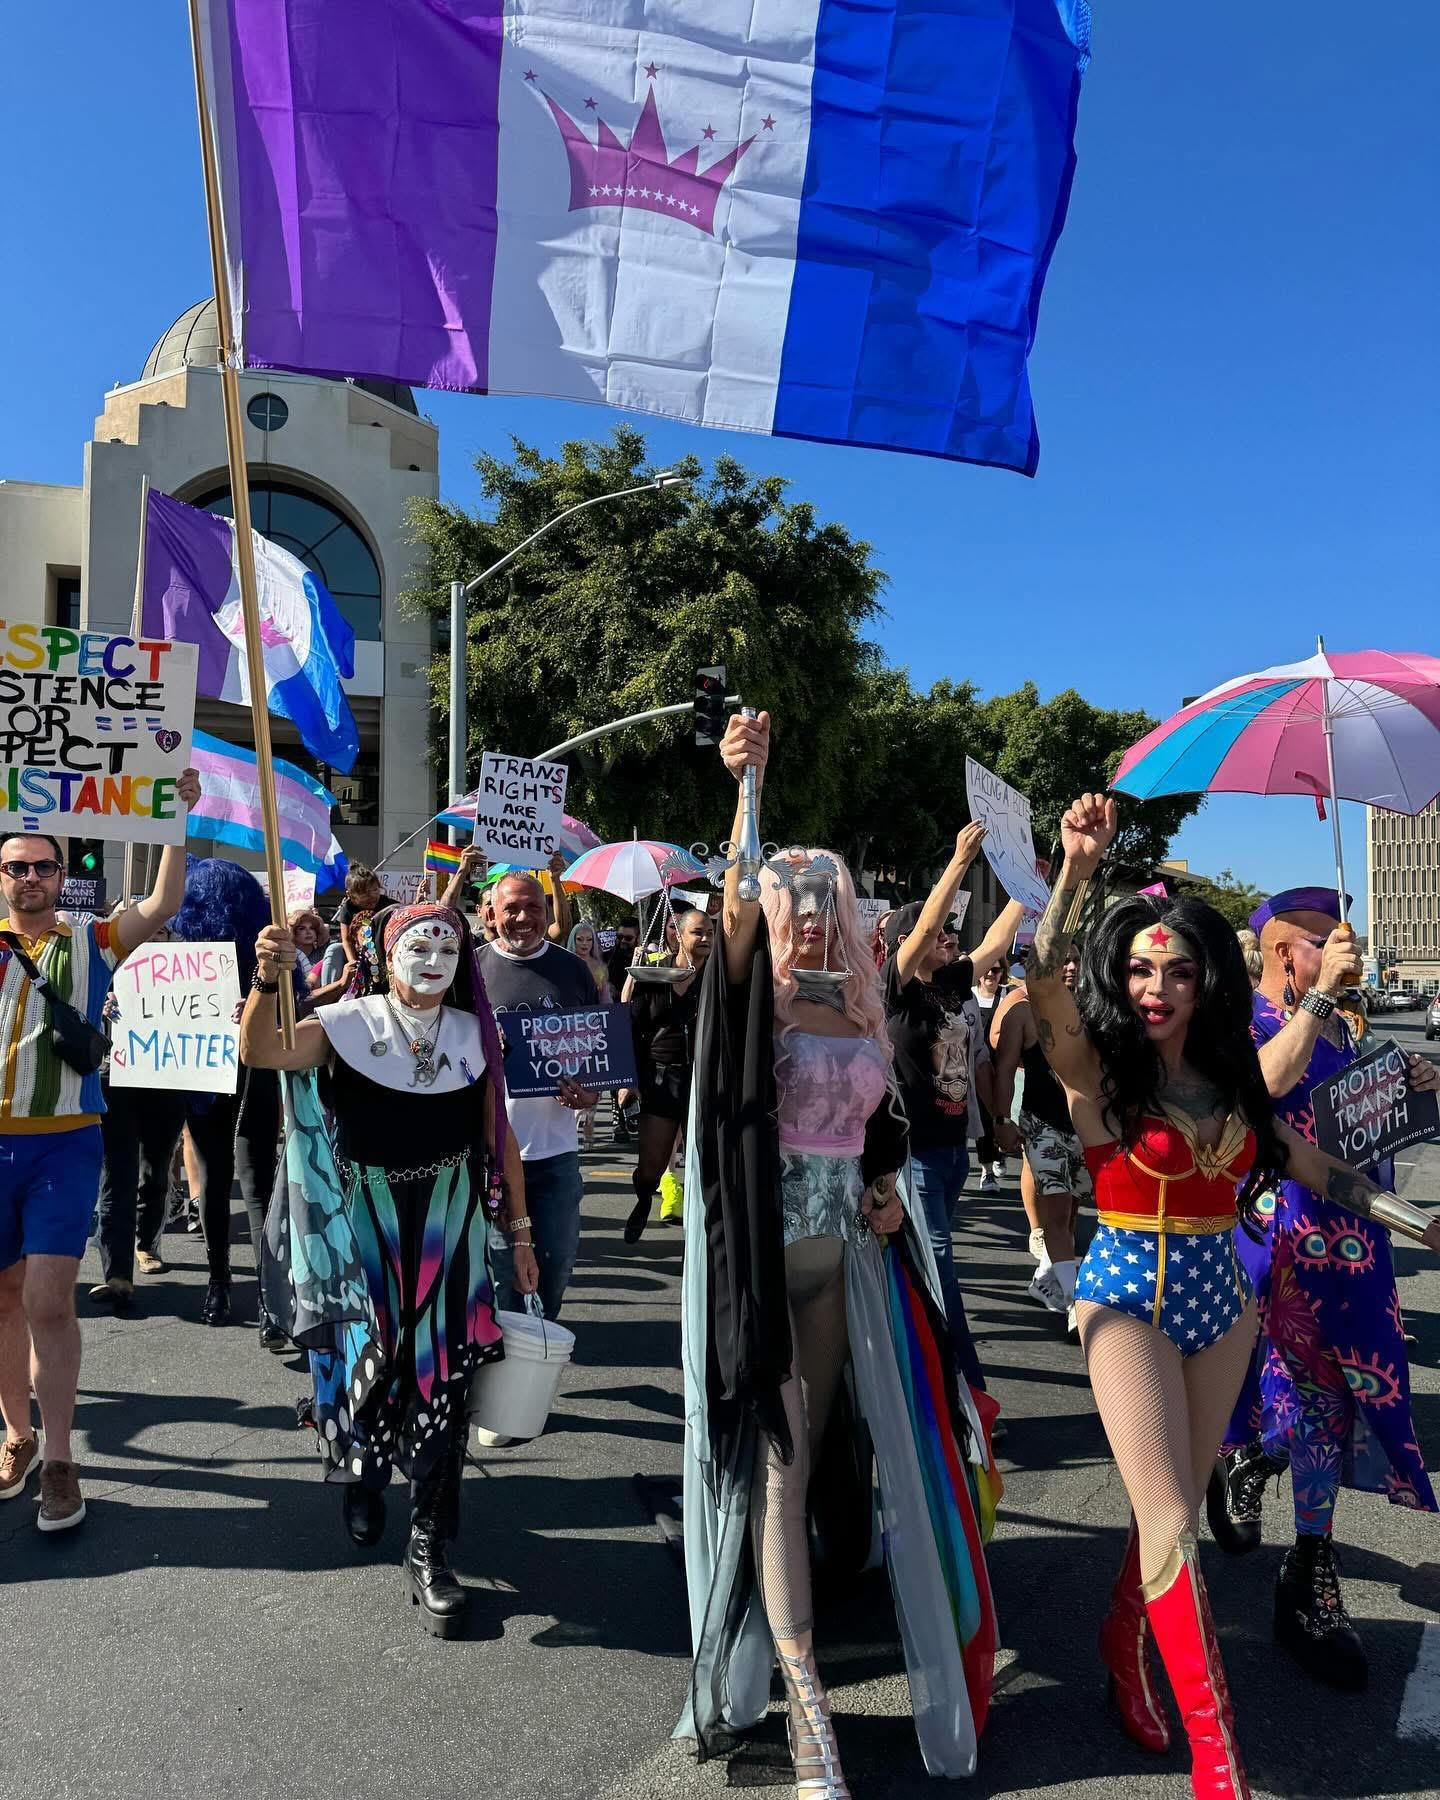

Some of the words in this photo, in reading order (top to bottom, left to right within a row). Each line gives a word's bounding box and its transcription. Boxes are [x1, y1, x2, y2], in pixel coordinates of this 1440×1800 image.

[0, 619, 172, 682] SPECT
[7, 704, 70, 741] OR
[0, 731, 138, 775] PECT
[488, 758, 566, 784] TRANS
[967, 760, 1002, 801] TAKING
[1002, 784, 1009, 808] A
[0, 767, 177, 819] ISTANCE
[484, 776, 563, 804] RIGHTS
[477, 813, 545, 834] HUMAN
[503, 803, 537, 819] ARE
[486, 829, 554, 855] RIGHTS
[61, 887, 95, 897] TRANS
[64, 879, 98, 889] ROTECT
[59, 895, 95, 905] YOUTH
[124, 951, 218, 993] TRANS
[142, 993, 221, 1020] LIVES
[520, 1011, 609, 1036] PROTECT
[128, 1029, 237, 1072] MATTER
[526, 1033, 608, 1058] TRANS
[529, 1054, 610, 1079] YOUTH
[1329, 1046, 1406, 1109] PROTECT
[1335, 1076, 1407, 1133] TRANS
[1338, 1102, 1408, 1160] YOUTH
